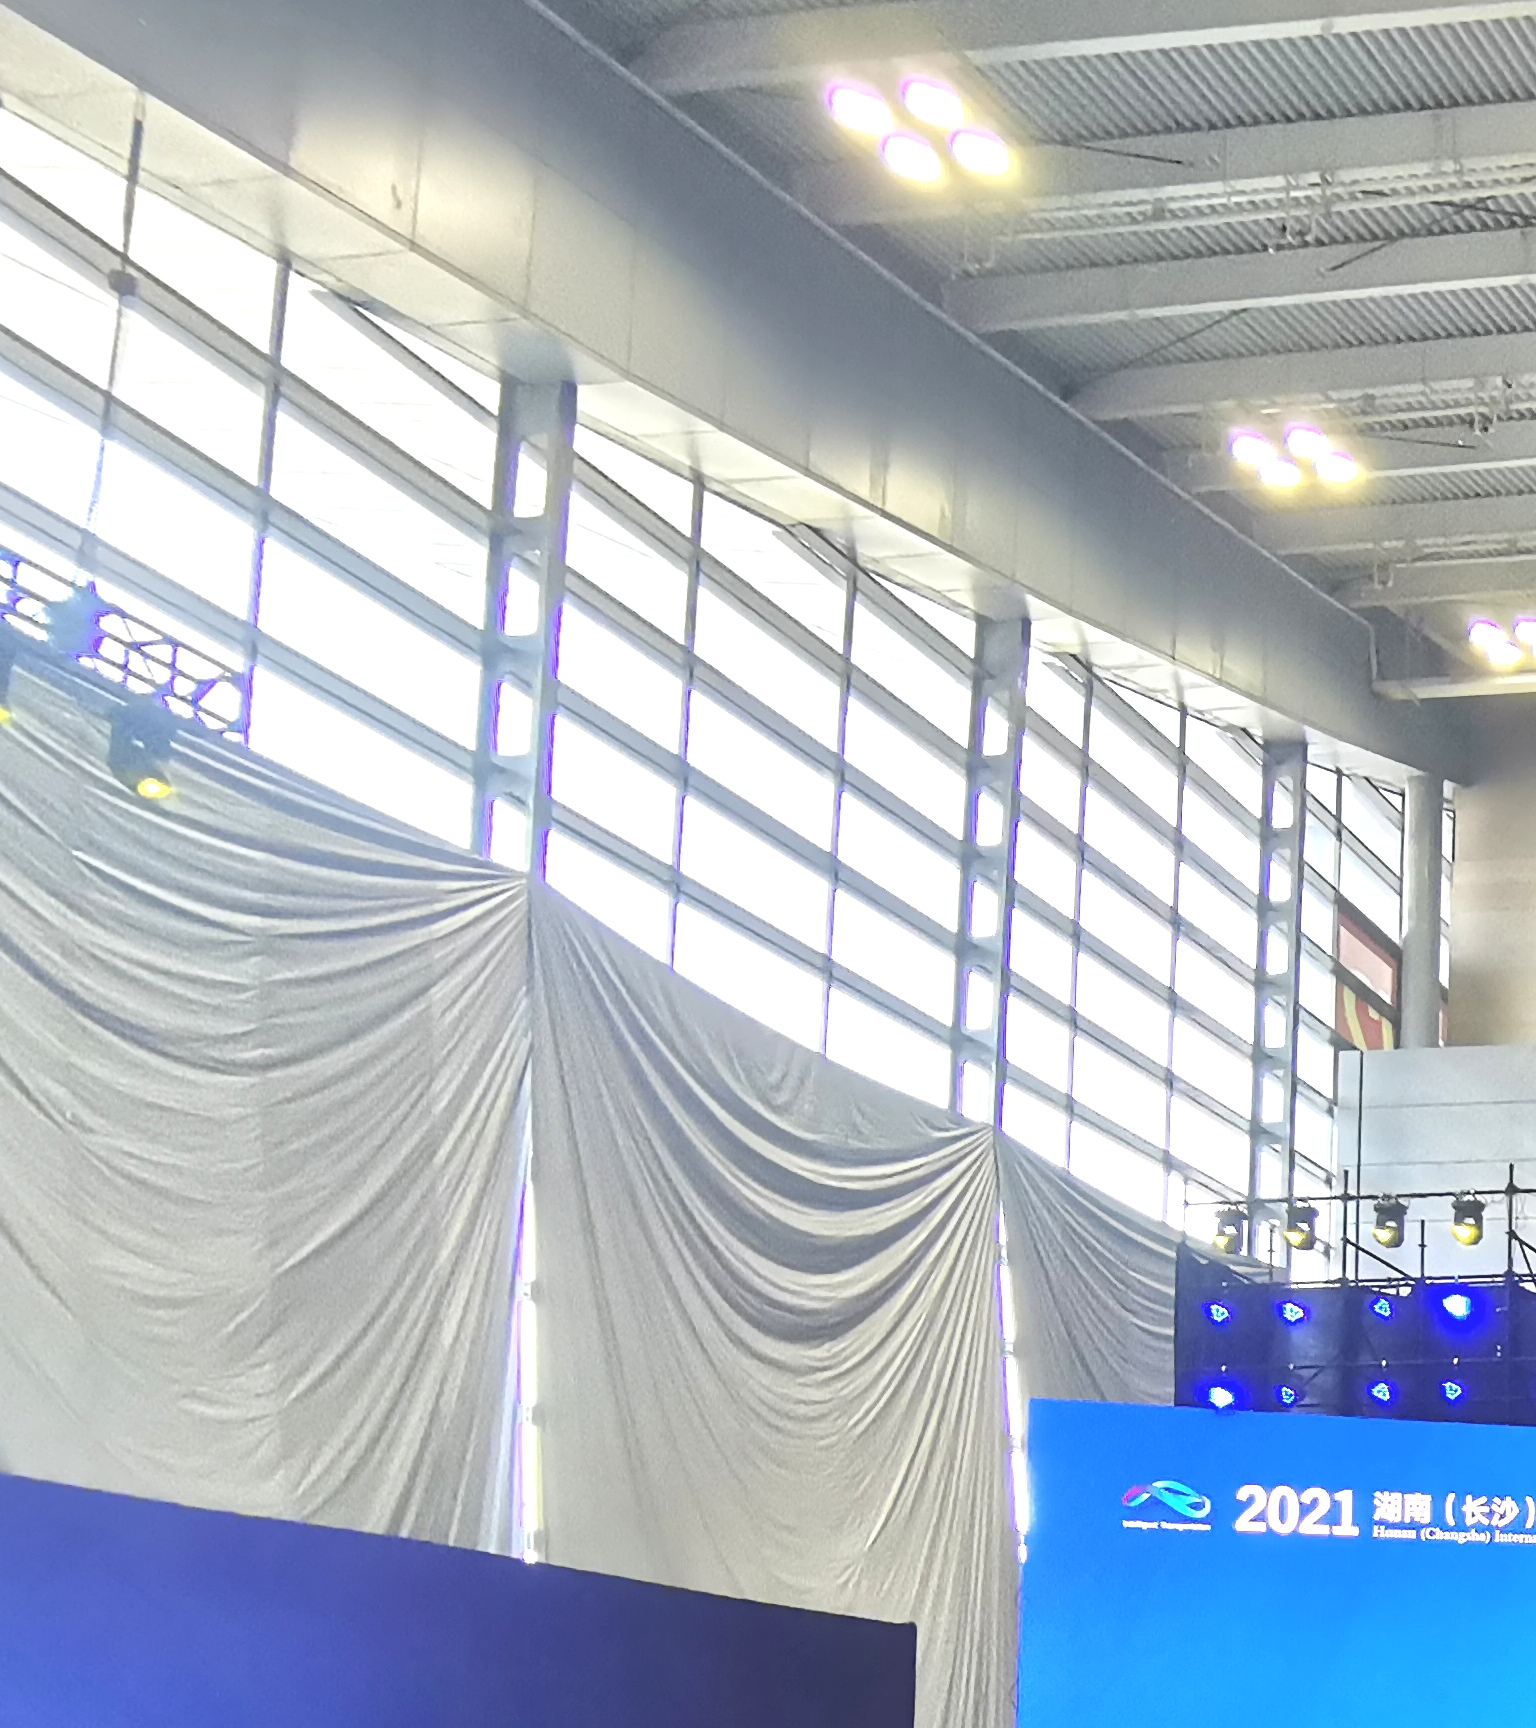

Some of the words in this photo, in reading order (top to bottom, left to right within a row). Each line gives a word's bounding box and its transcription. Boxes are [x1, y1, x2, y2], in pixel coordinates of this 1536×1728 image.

[1233, 1484, 1360, 1538] 2021
[1372, 1525, 1417, 1539] Hunan
[1420, 1526, 1491, 1545] (Changsha)
